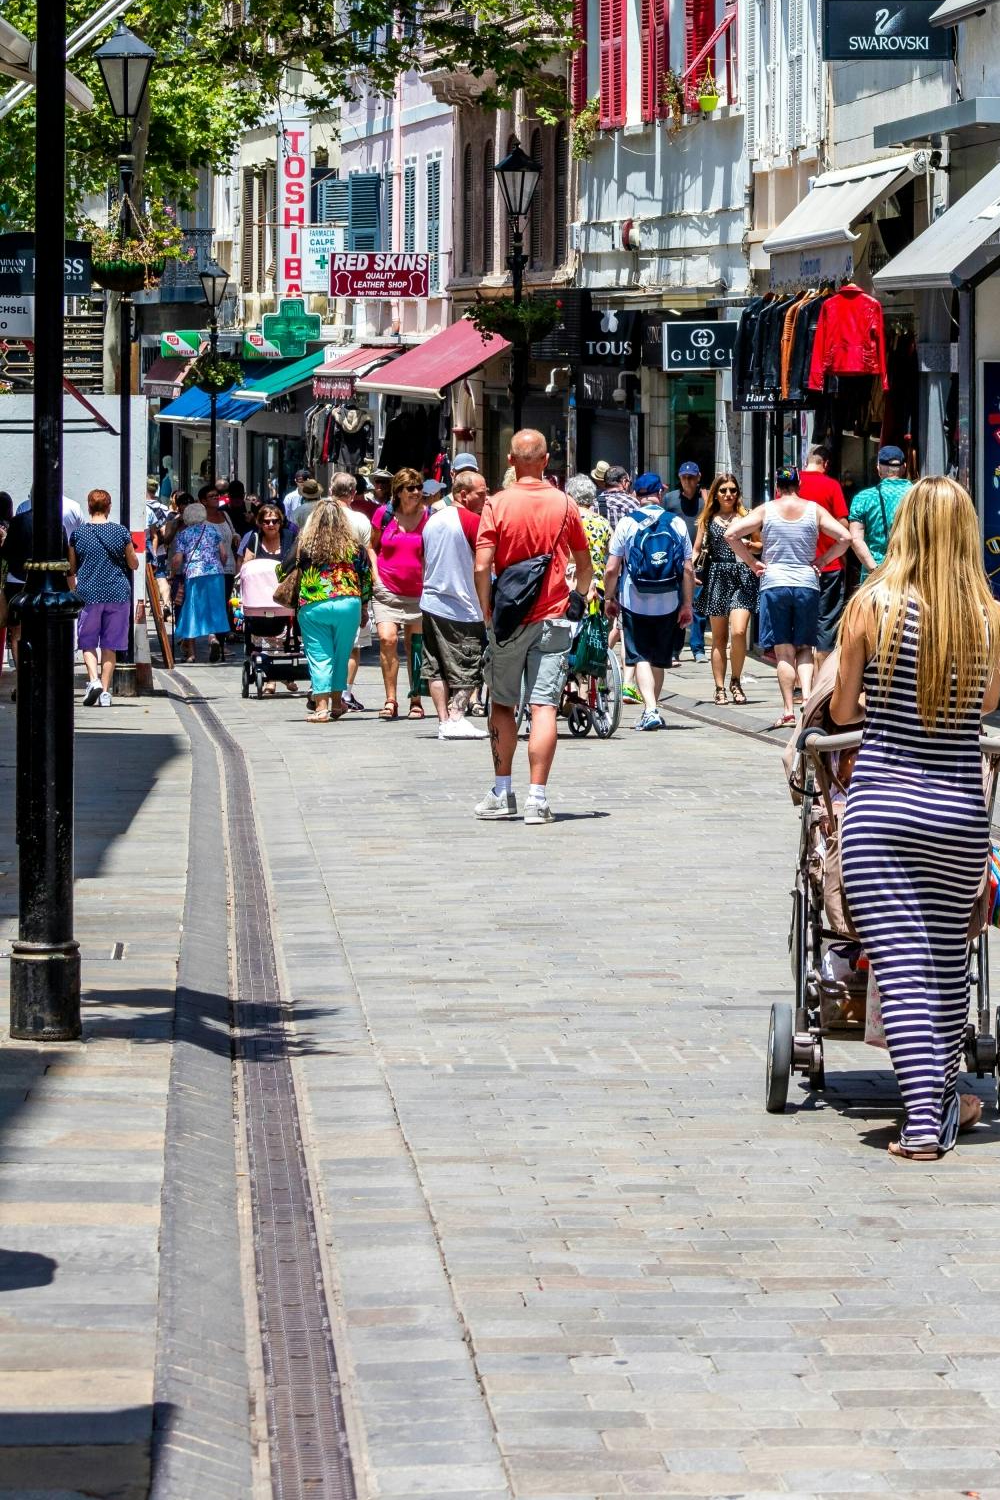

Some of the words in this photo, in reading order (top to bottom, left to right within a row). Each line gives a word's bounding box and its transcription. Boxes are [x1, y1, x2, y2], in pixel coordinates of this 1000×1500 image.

[849, 36, 929, 50] SWAROVSKI
[284, 131, 306, 298] TOSHIBA
[309, 238, 335, 246] CALPE
[333, 254, 369, 271] RED
[373, 254, 428, 271] SKINS
[365, 272, 396, 280] QUALITY
[585, 341, 633, 356] TOUS
[745, 393, 766, 403] Hair
[767, 393, 775, 403] &
